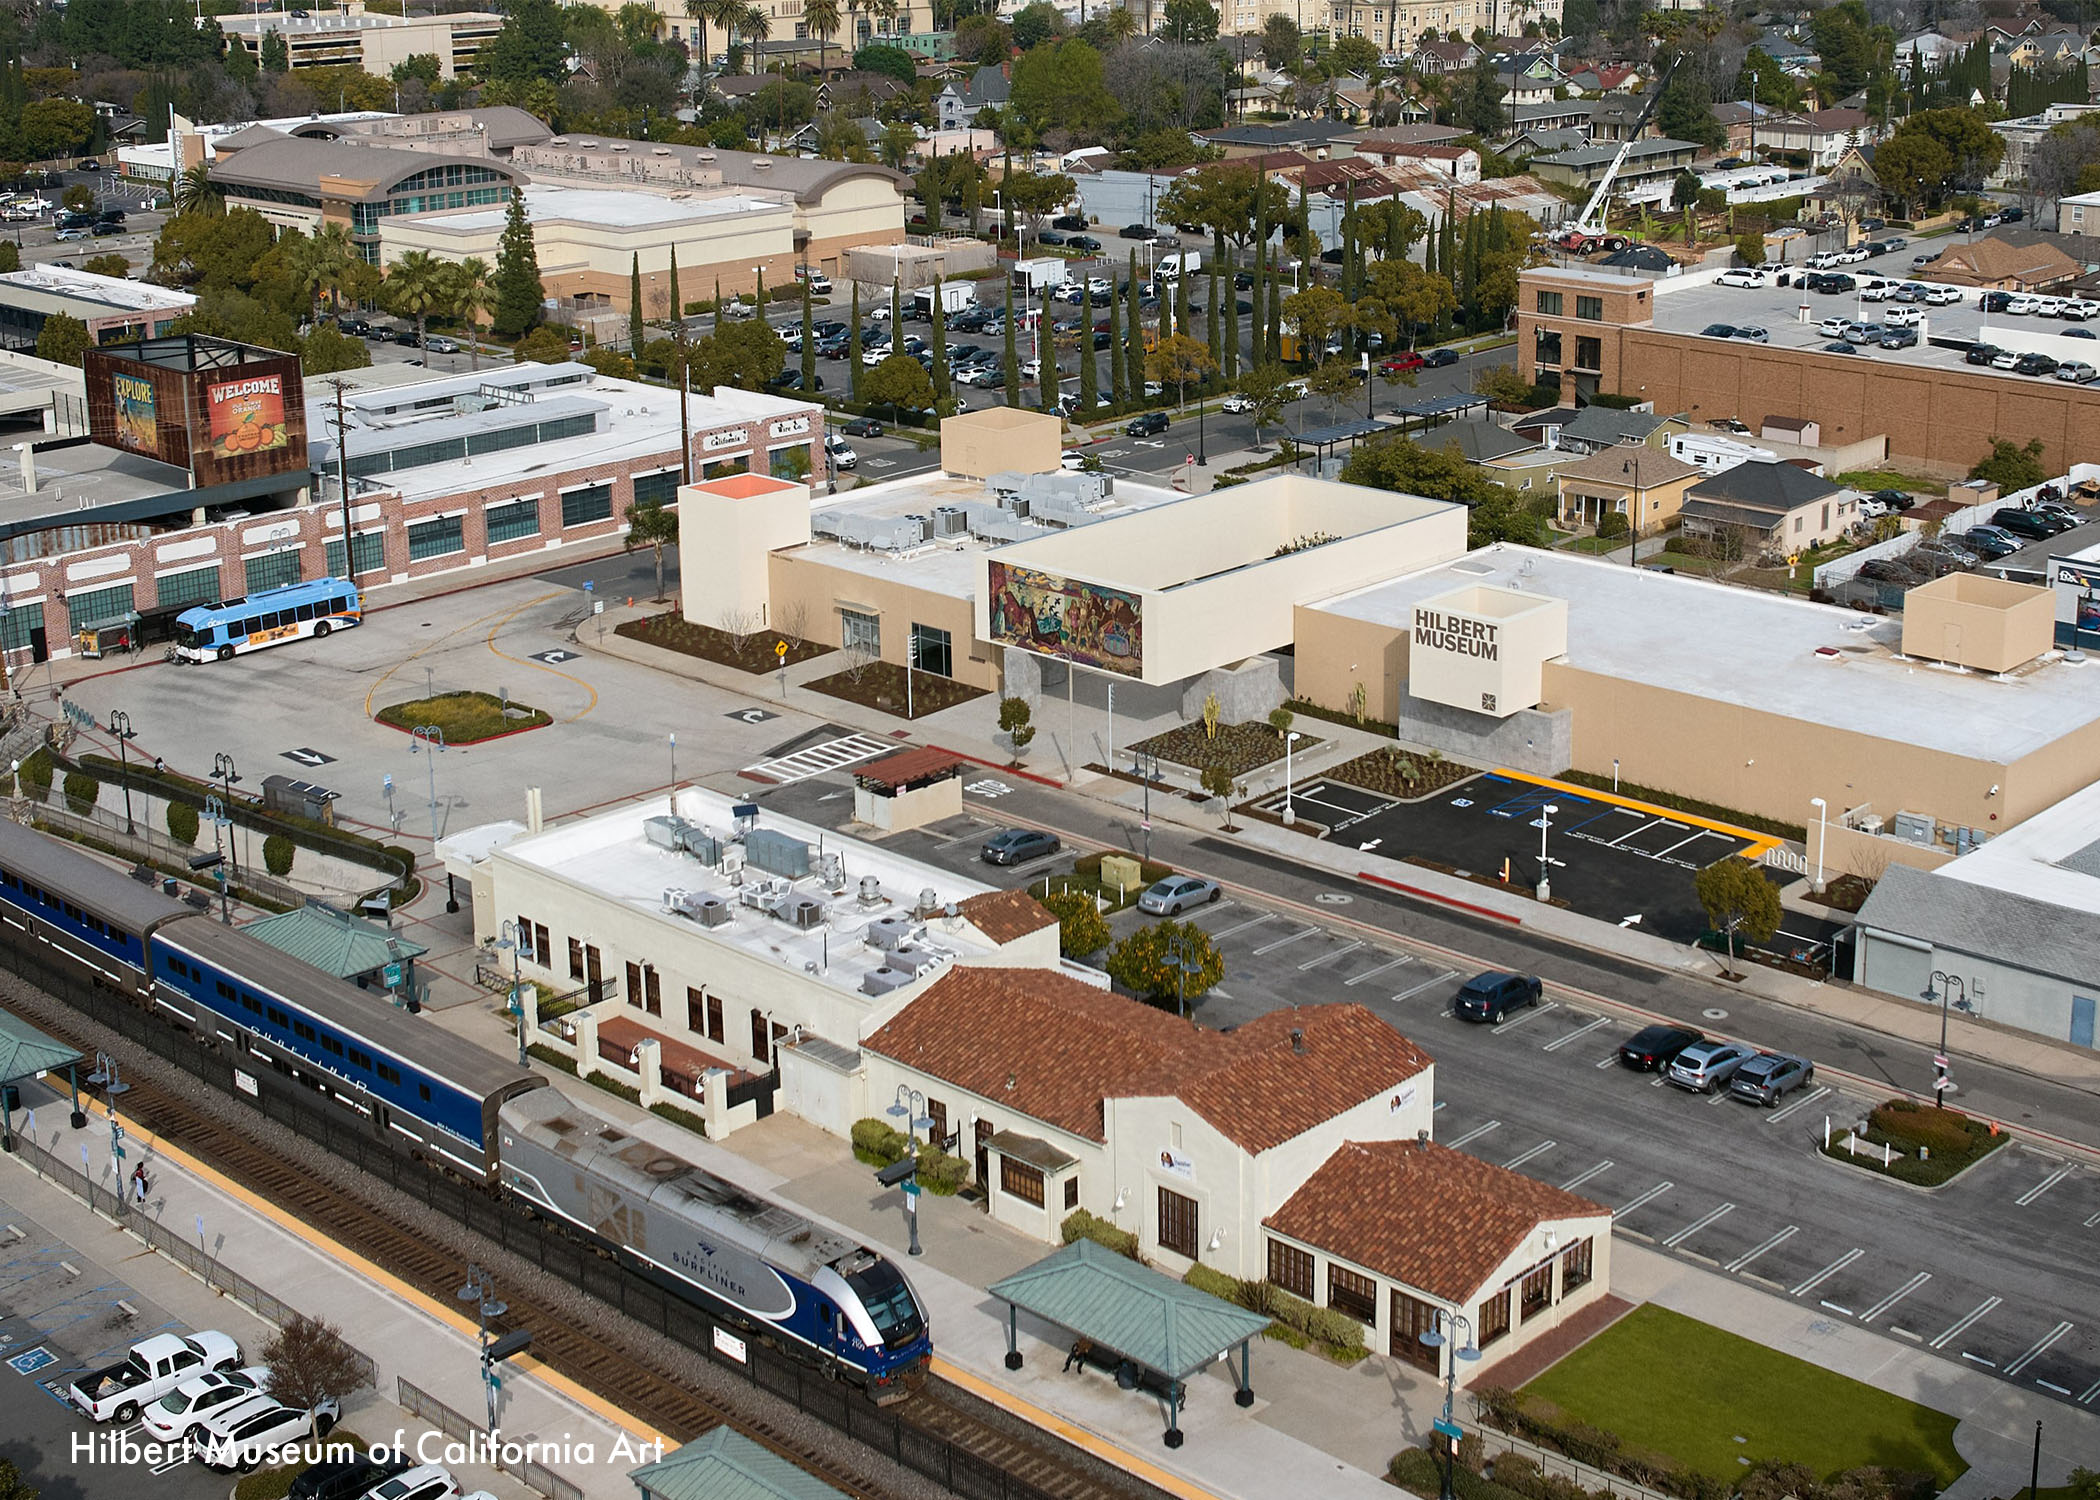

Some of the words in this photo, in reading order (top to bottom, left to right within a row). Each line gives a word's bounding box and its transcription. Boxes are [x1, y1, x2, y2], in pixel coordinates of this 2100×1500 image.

[115, 376, 152, 403] EXPLORE
[211, 377, 280, 404] WELCOME
[1415, 608, 1498, 642] HILBERT
[1415, 626, 1498, 662] MUSEUM
[250, 1025, 367, 1094] SURFLINER
[672, 1251, 746, 1297] SURFLINER
